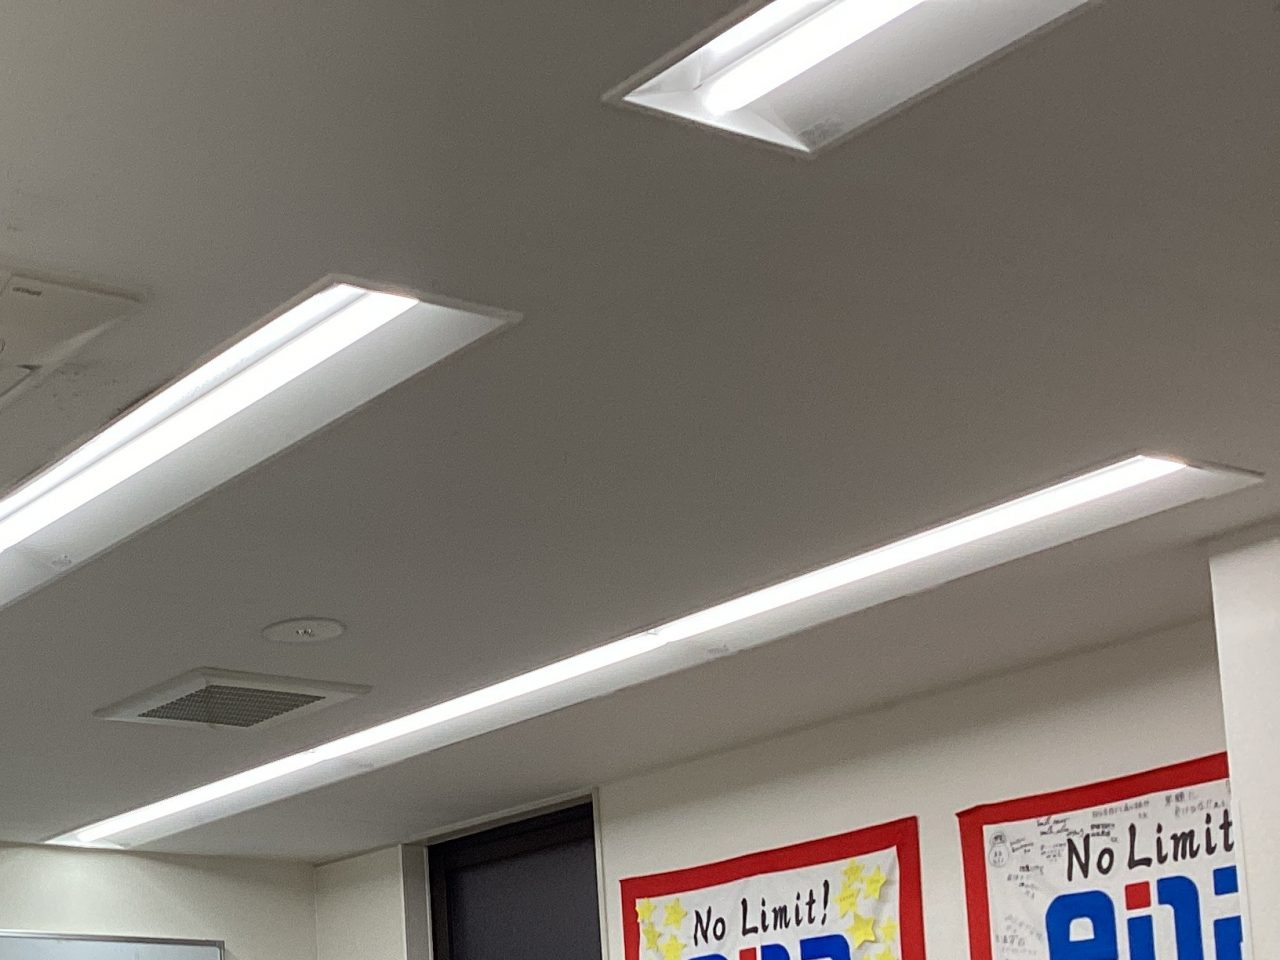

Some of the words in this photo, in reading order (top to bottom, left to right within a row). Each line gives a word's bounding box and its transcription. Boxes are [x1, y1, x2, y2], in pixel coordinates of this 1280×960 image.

[1067, 833, 1114, 882] No
[693, 906, 727, 946] No
[741, 879, 831, 937] Limit!
